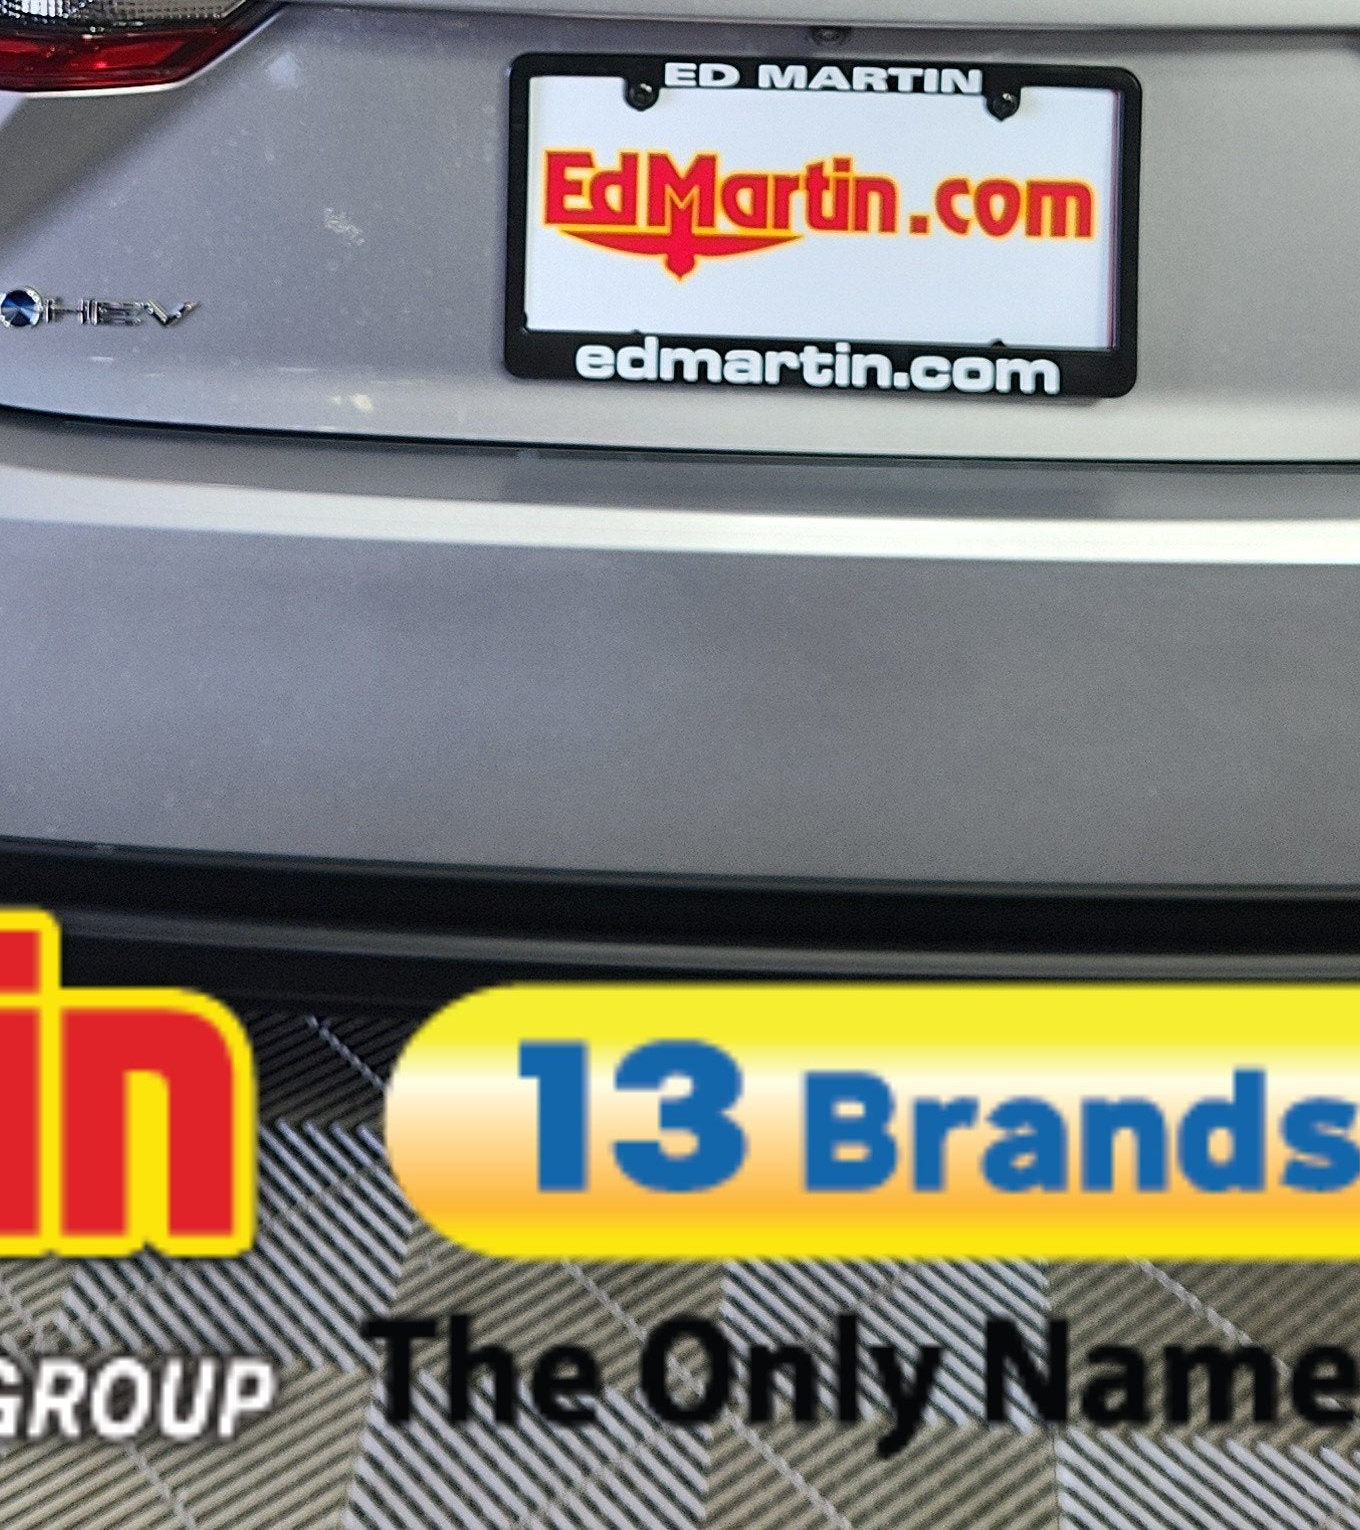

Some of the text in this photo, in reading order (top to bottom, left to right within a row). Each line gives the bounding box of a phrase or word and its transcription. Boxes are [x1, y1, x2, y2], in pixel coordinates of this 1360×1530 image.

[665, 62, 983, 95] ED MARTIN
[575, 337, 1061, 395] edmartin.com
